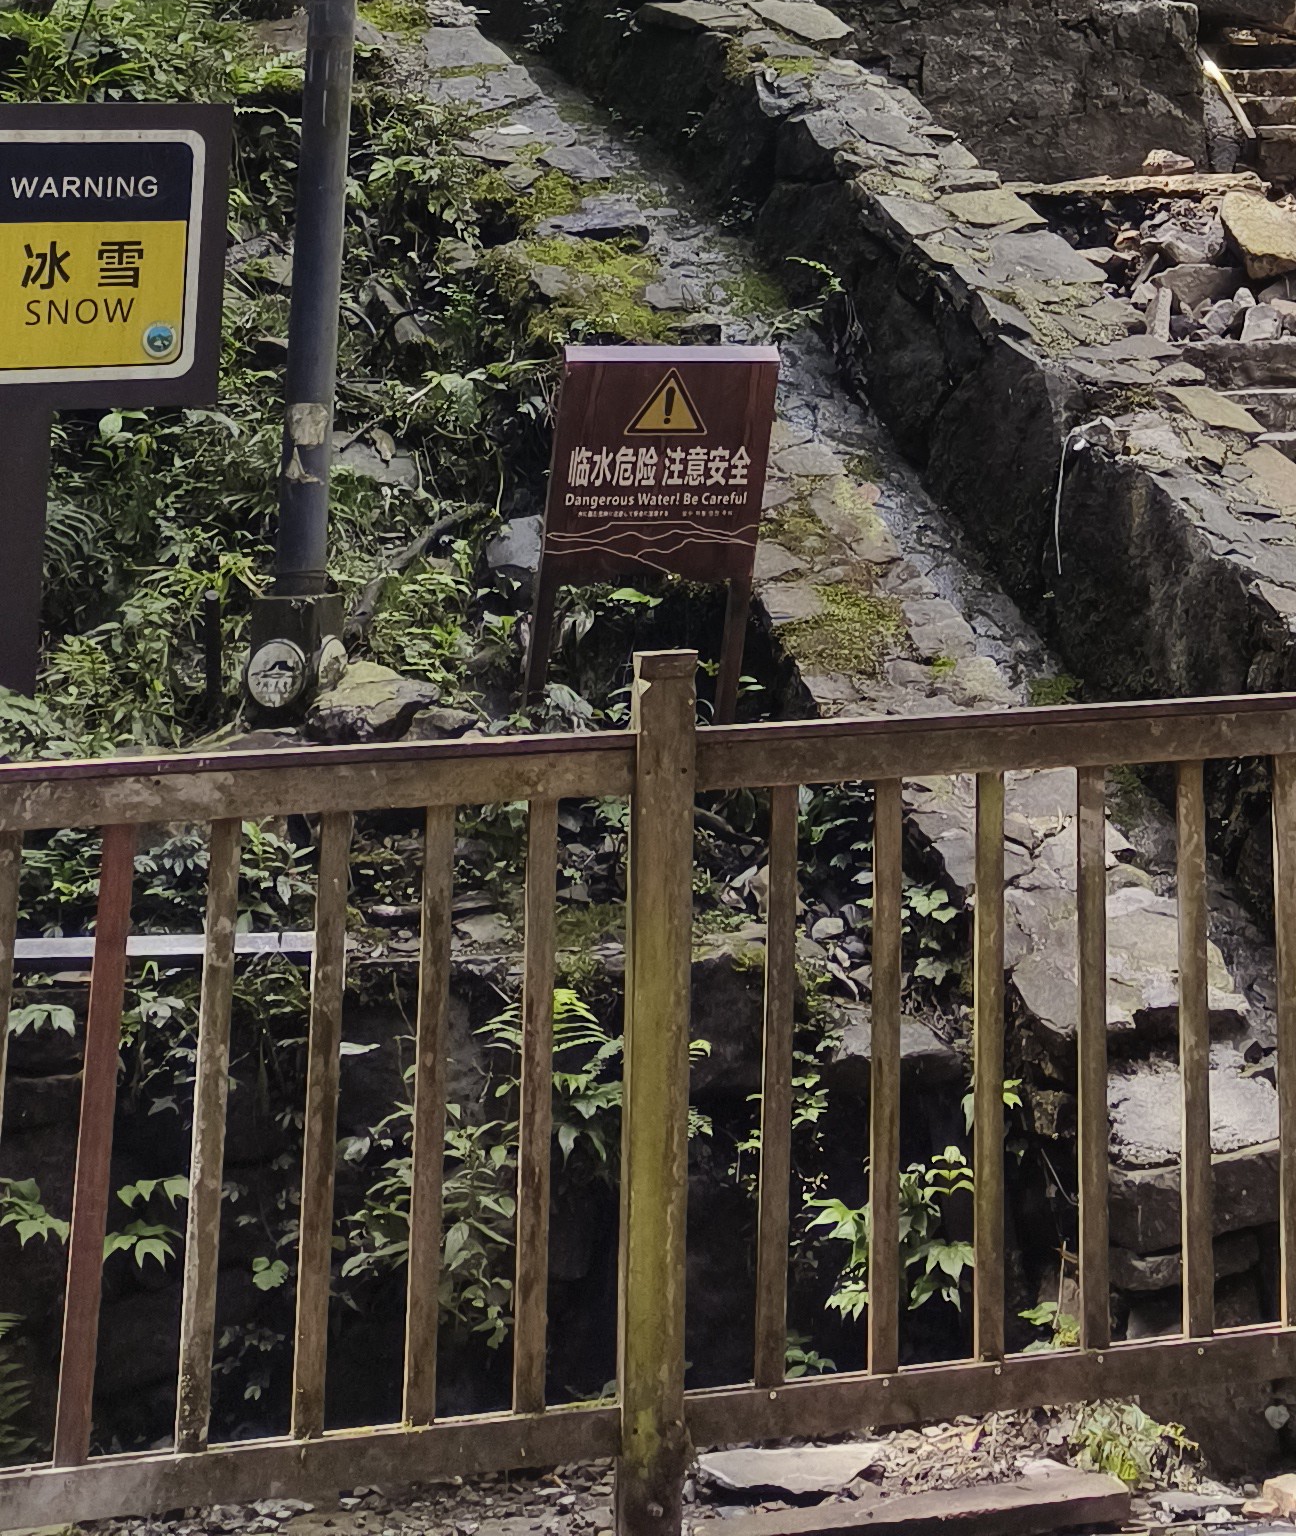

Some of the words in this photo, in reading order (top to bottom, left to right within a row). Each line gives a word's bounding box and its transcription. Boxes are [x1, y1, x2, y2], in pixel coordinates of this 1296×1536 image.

[11, 175, 159, 199] WARNING
[21, 240, 144, 290] 冰雪
[25, 297, 135, 325] SNOW
[567, 445, 659, 487] 临水危险
[661, 445, 751, 487] 注意安全
[565, 492, 635, 509] Dangerous
[638, 492, 680, 506] Water!
[683, 492, 699, 505] Be
[701, 491, 748, 505] Careful
